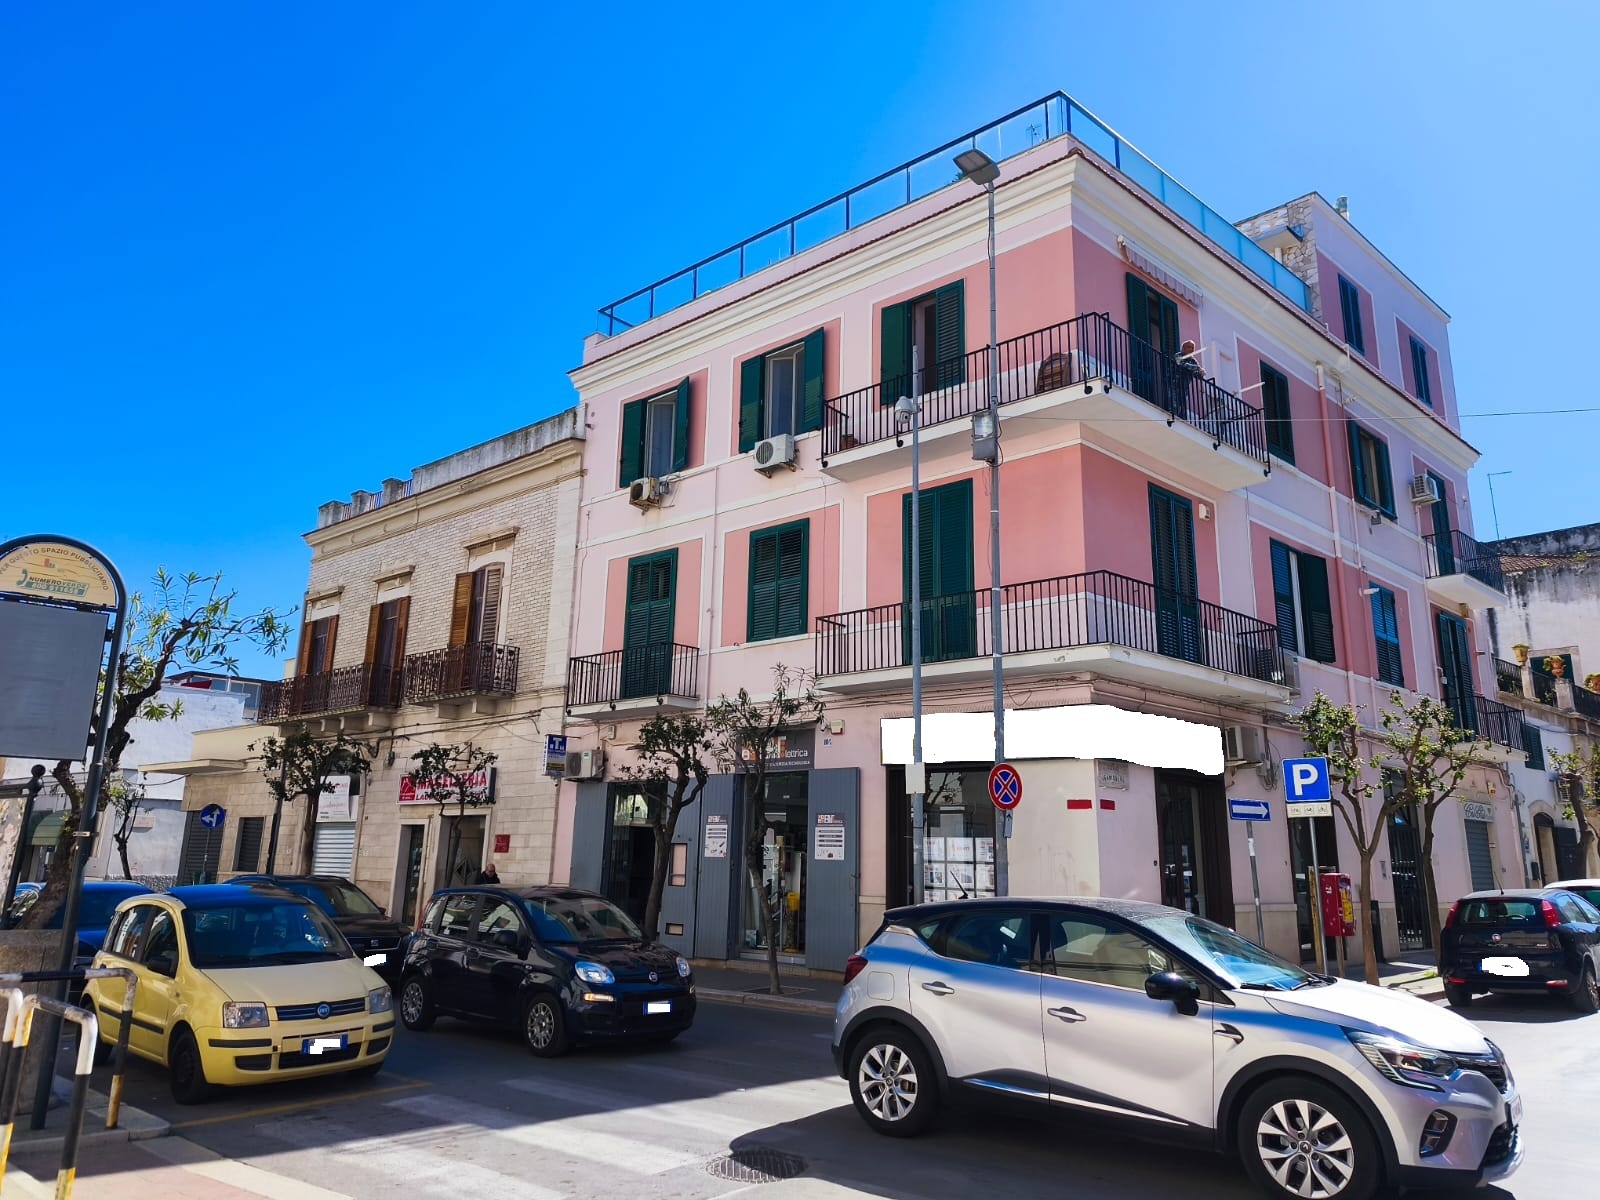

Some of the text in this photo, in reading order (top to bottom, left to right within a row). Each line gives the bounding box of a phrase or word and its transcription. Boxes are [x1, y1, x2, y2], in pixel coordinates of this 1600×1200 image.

[41, 547, 68, 556] SPAZIO
[70, 552, 109, 591] PUBBLICITARIO
[1292, 763, 1319, 796] P
